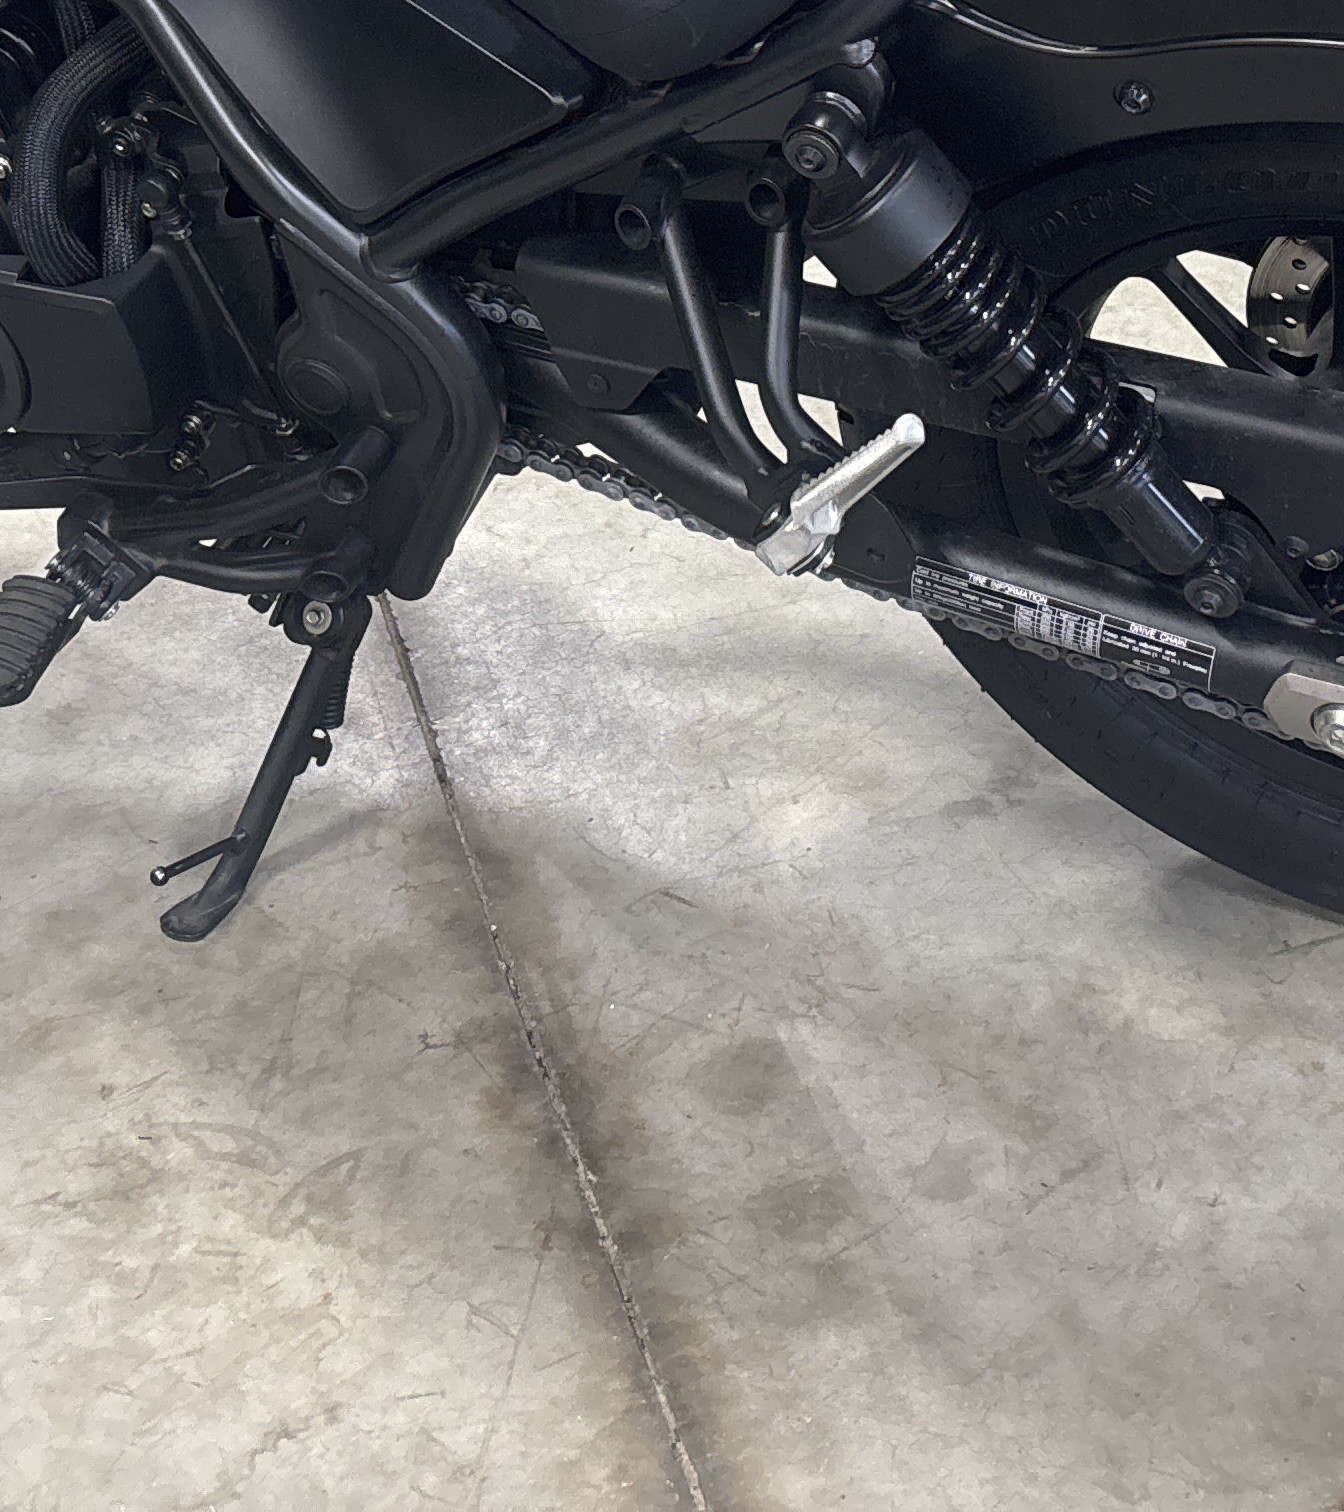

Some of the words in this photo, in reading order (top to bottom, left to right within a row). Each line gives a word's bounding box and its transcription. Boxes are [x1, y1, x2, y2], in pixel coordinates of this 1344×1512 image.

[990, 578, 1048, 604] INFORMATION
[1129, 622, 1157, 640] DRIVE
[1160, 631, 1187, 648] CHAIN
